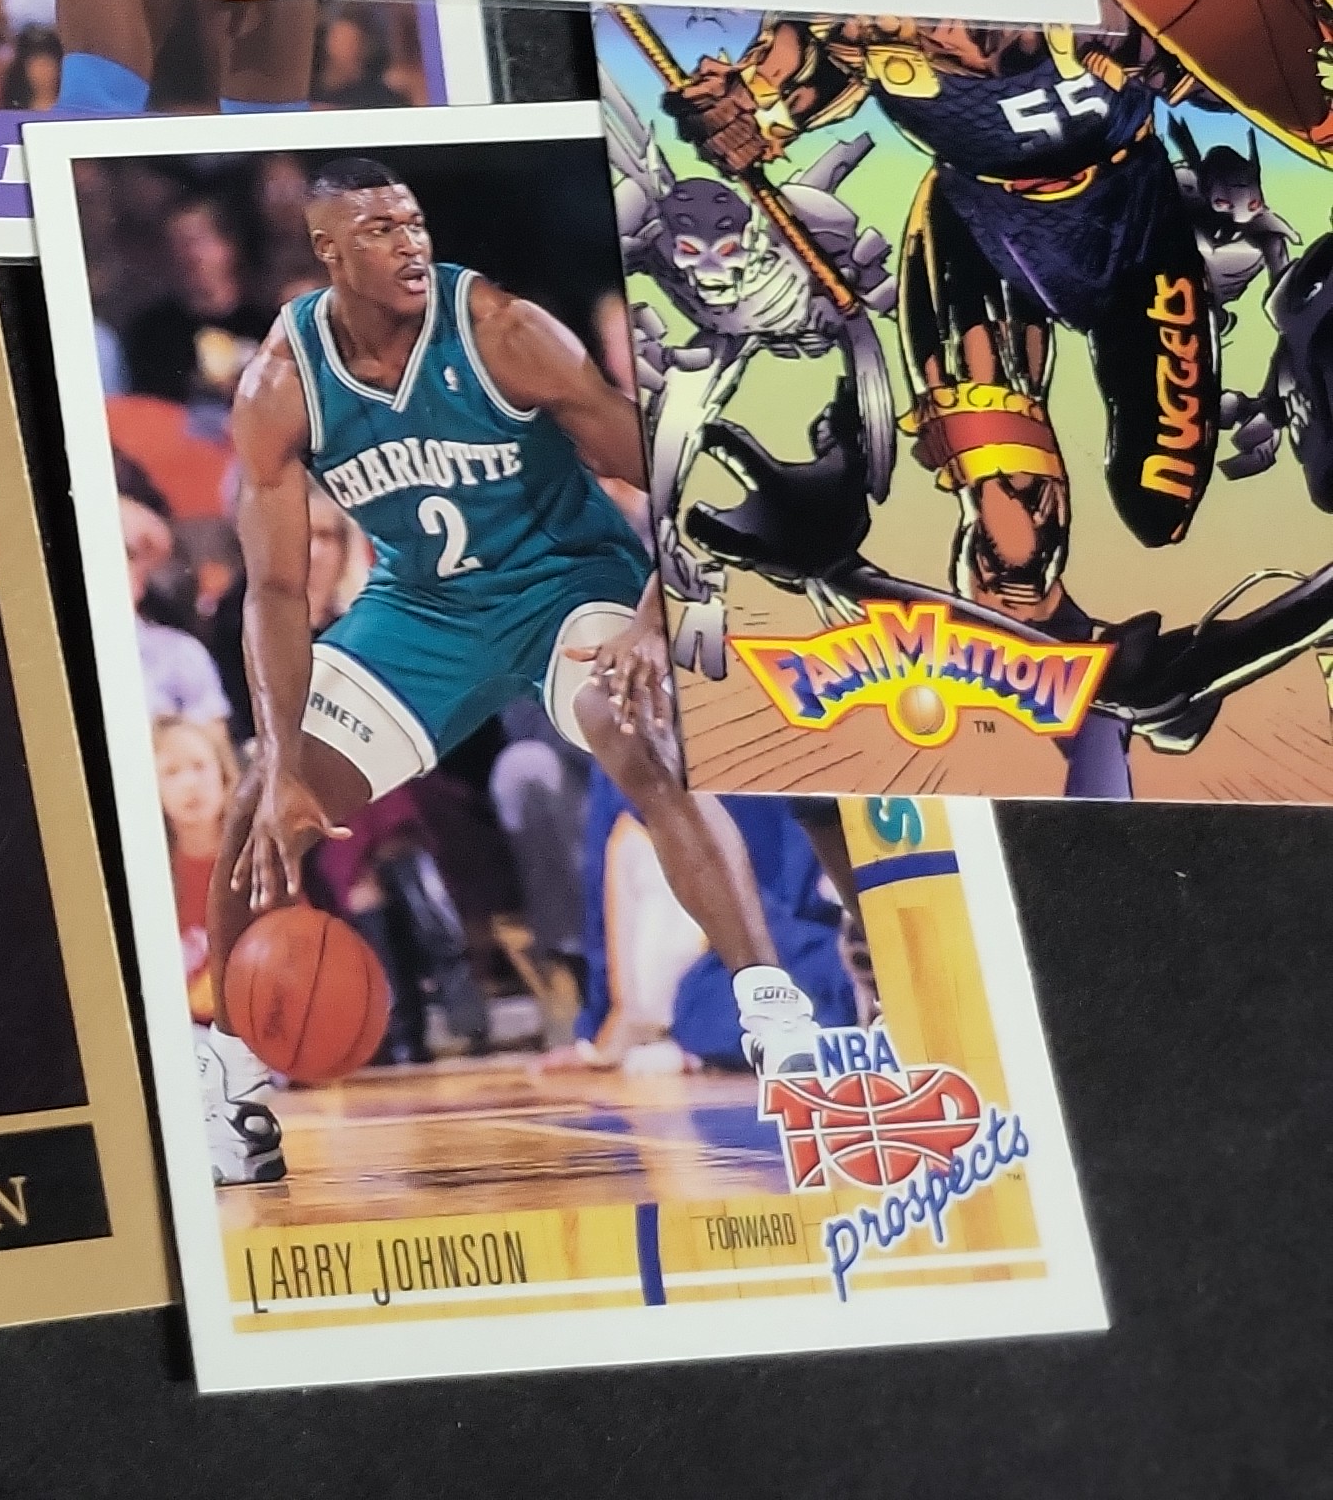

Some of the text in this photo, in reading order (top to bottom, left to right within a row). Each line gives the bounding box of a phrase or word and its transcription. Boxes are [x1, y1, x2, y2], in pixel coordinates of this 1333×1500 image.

[997, 72, 1111, 143] 55
[322, 437, 523, 509] CHARLOTTE
[417, 495, 484, 578] 2
[816, 1030, 900, 1078] NBA
[706, 1212, 798, 1251] FORWARD
[826, 1108, 1030, 1303] prospects
[244, 1230, 529, 1315] LARRY JOHNSON
